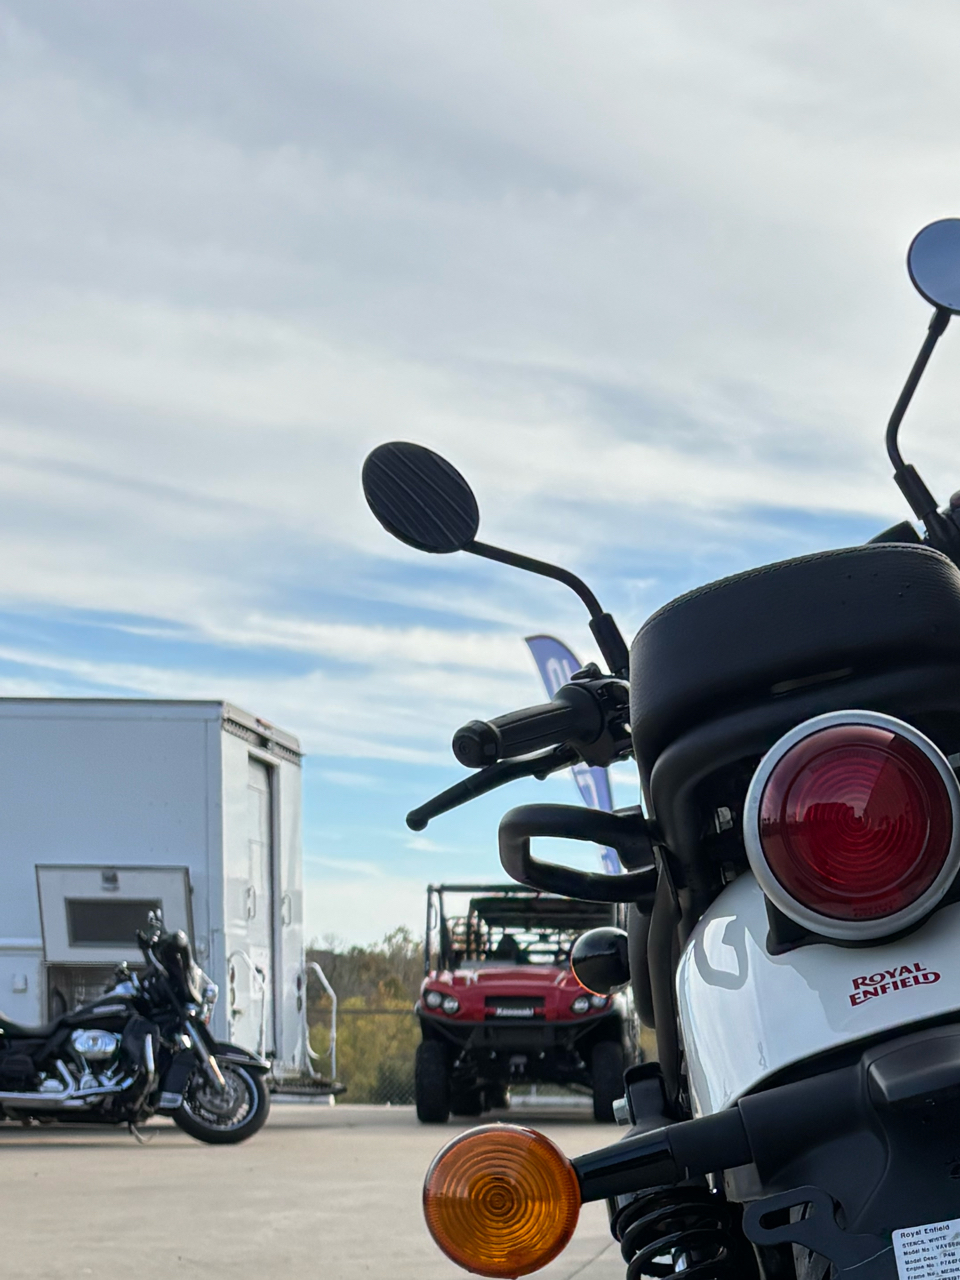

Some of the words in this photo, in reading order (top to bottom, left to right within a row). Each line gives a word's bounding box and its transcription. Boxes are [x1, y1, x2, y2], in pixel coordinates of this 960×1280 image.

[852, 962, 927, 990] ROYAL
[849, 971, 941, 1007] ENFIELD
[900, 1229, 921, 1239] Royal
[924, 1224, 949, 1234] Enfield
[928, 1235, 946, 1243] WHITE
[903, 1248, 919, 1256] Model
[904, 1257, 921, 1265] Model
[906, 1264, 924, 1273] Engine
